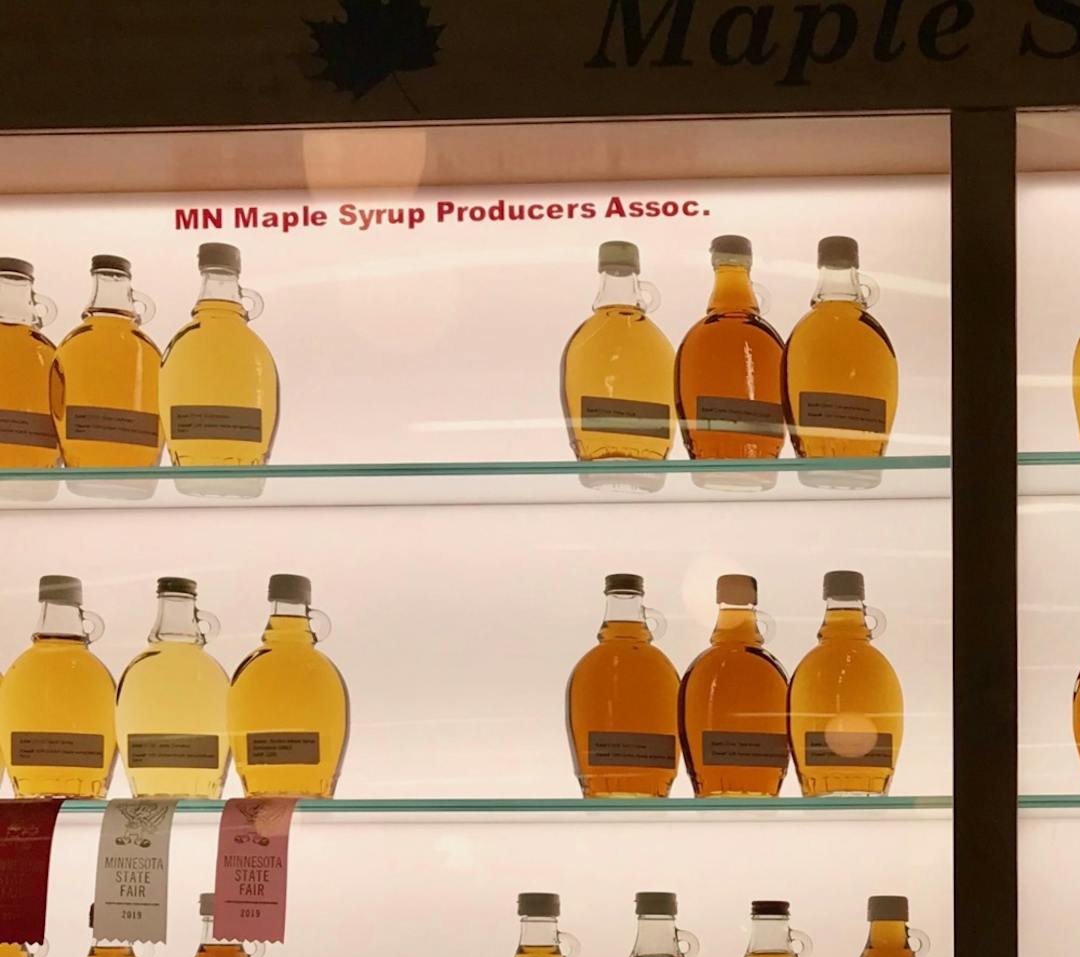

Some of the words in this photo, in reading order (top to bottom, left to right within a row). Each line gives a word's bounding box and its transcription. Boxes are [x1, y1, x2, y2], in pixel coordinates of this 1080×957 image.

[584, 0, 975, 87] Maple
[175, 208, 223, 230] MN
[234, 206, 328, 233] Maple
[339, 203, 426, 231] Syrup
[437, 200, 597, 223] Producers
[604, 196, 711, 218] Assoc.
[104, 855, 164, 870] MINNESOTA
[223, 855, 283, 868] MINNESOTA
[115, 870, 151, 884] STATE
[234, 869, 270, 882] STATE
[119, 884, 146, 898] FAIR
[239, 883, 265, 896] FAIR
[121, 909, 142, 920] 2019
[240, 908, 261, 918] 2019
